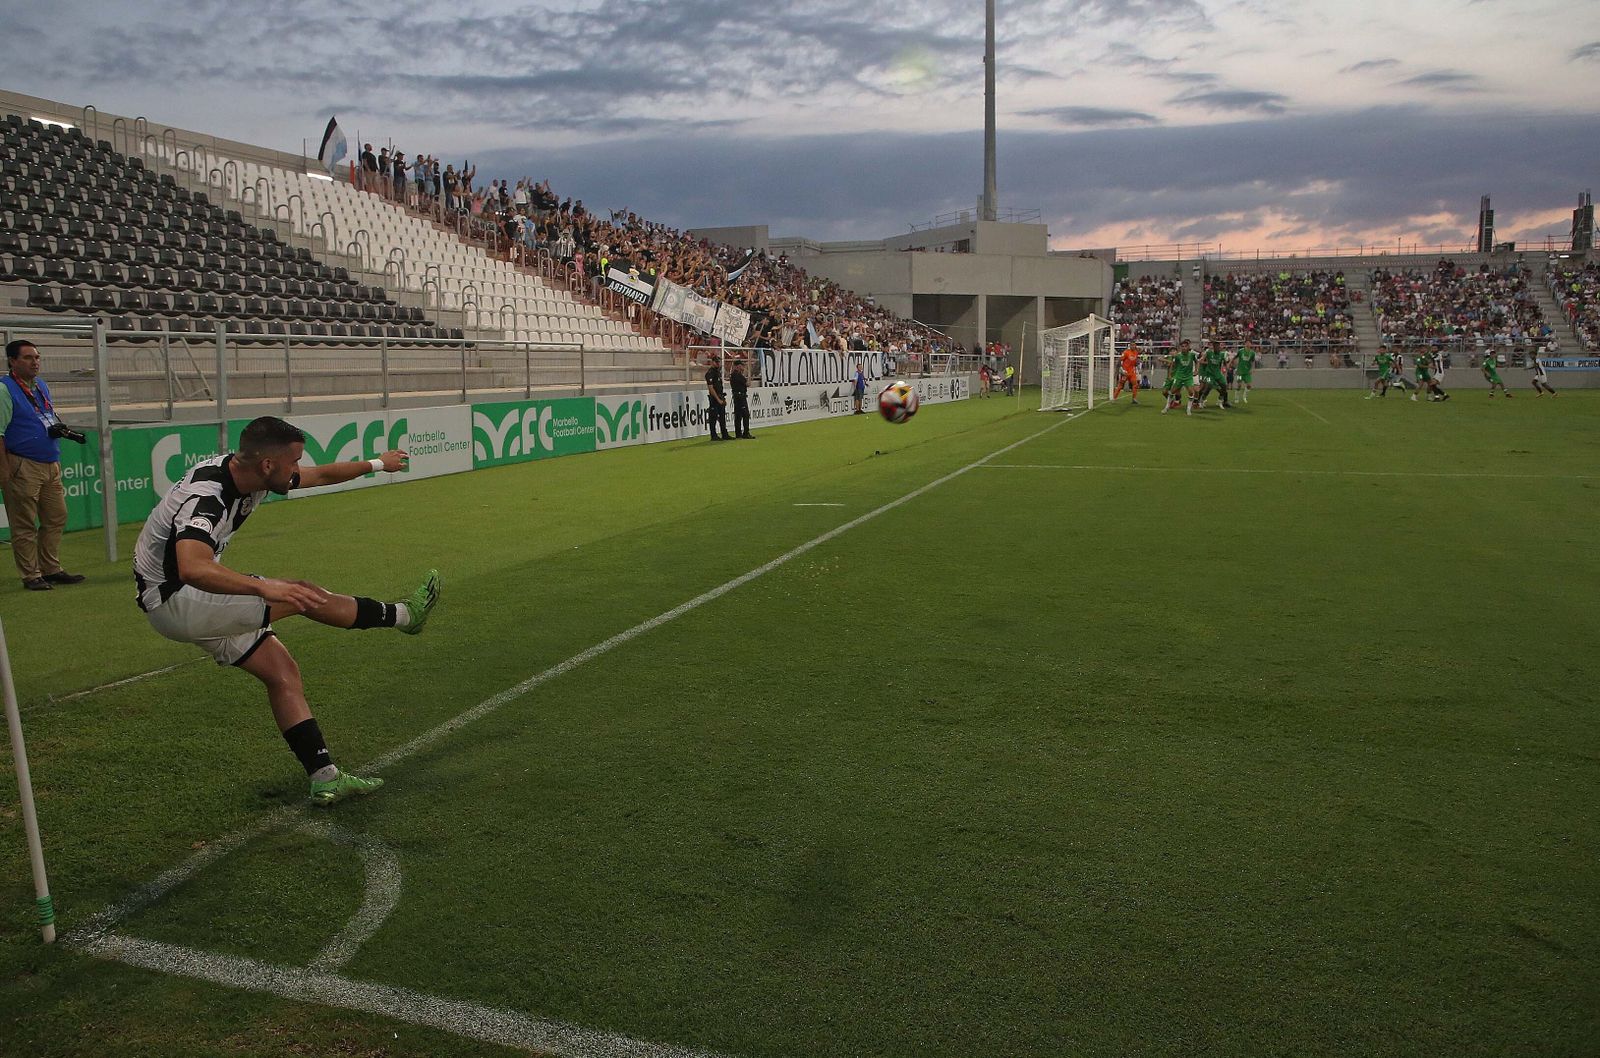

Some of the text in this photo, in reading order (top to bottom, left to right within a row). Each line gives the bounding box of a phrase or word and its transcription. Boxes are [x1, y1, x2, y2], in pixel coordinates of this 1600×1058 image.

[553, 416, 578, 427] Marbella
[409, 430, 445, 444] Marbella
[553, 425, 595, 437] Football Center
[409, 441, 470, 457] Football Center
[93, 477, 150, 494] Cnter
